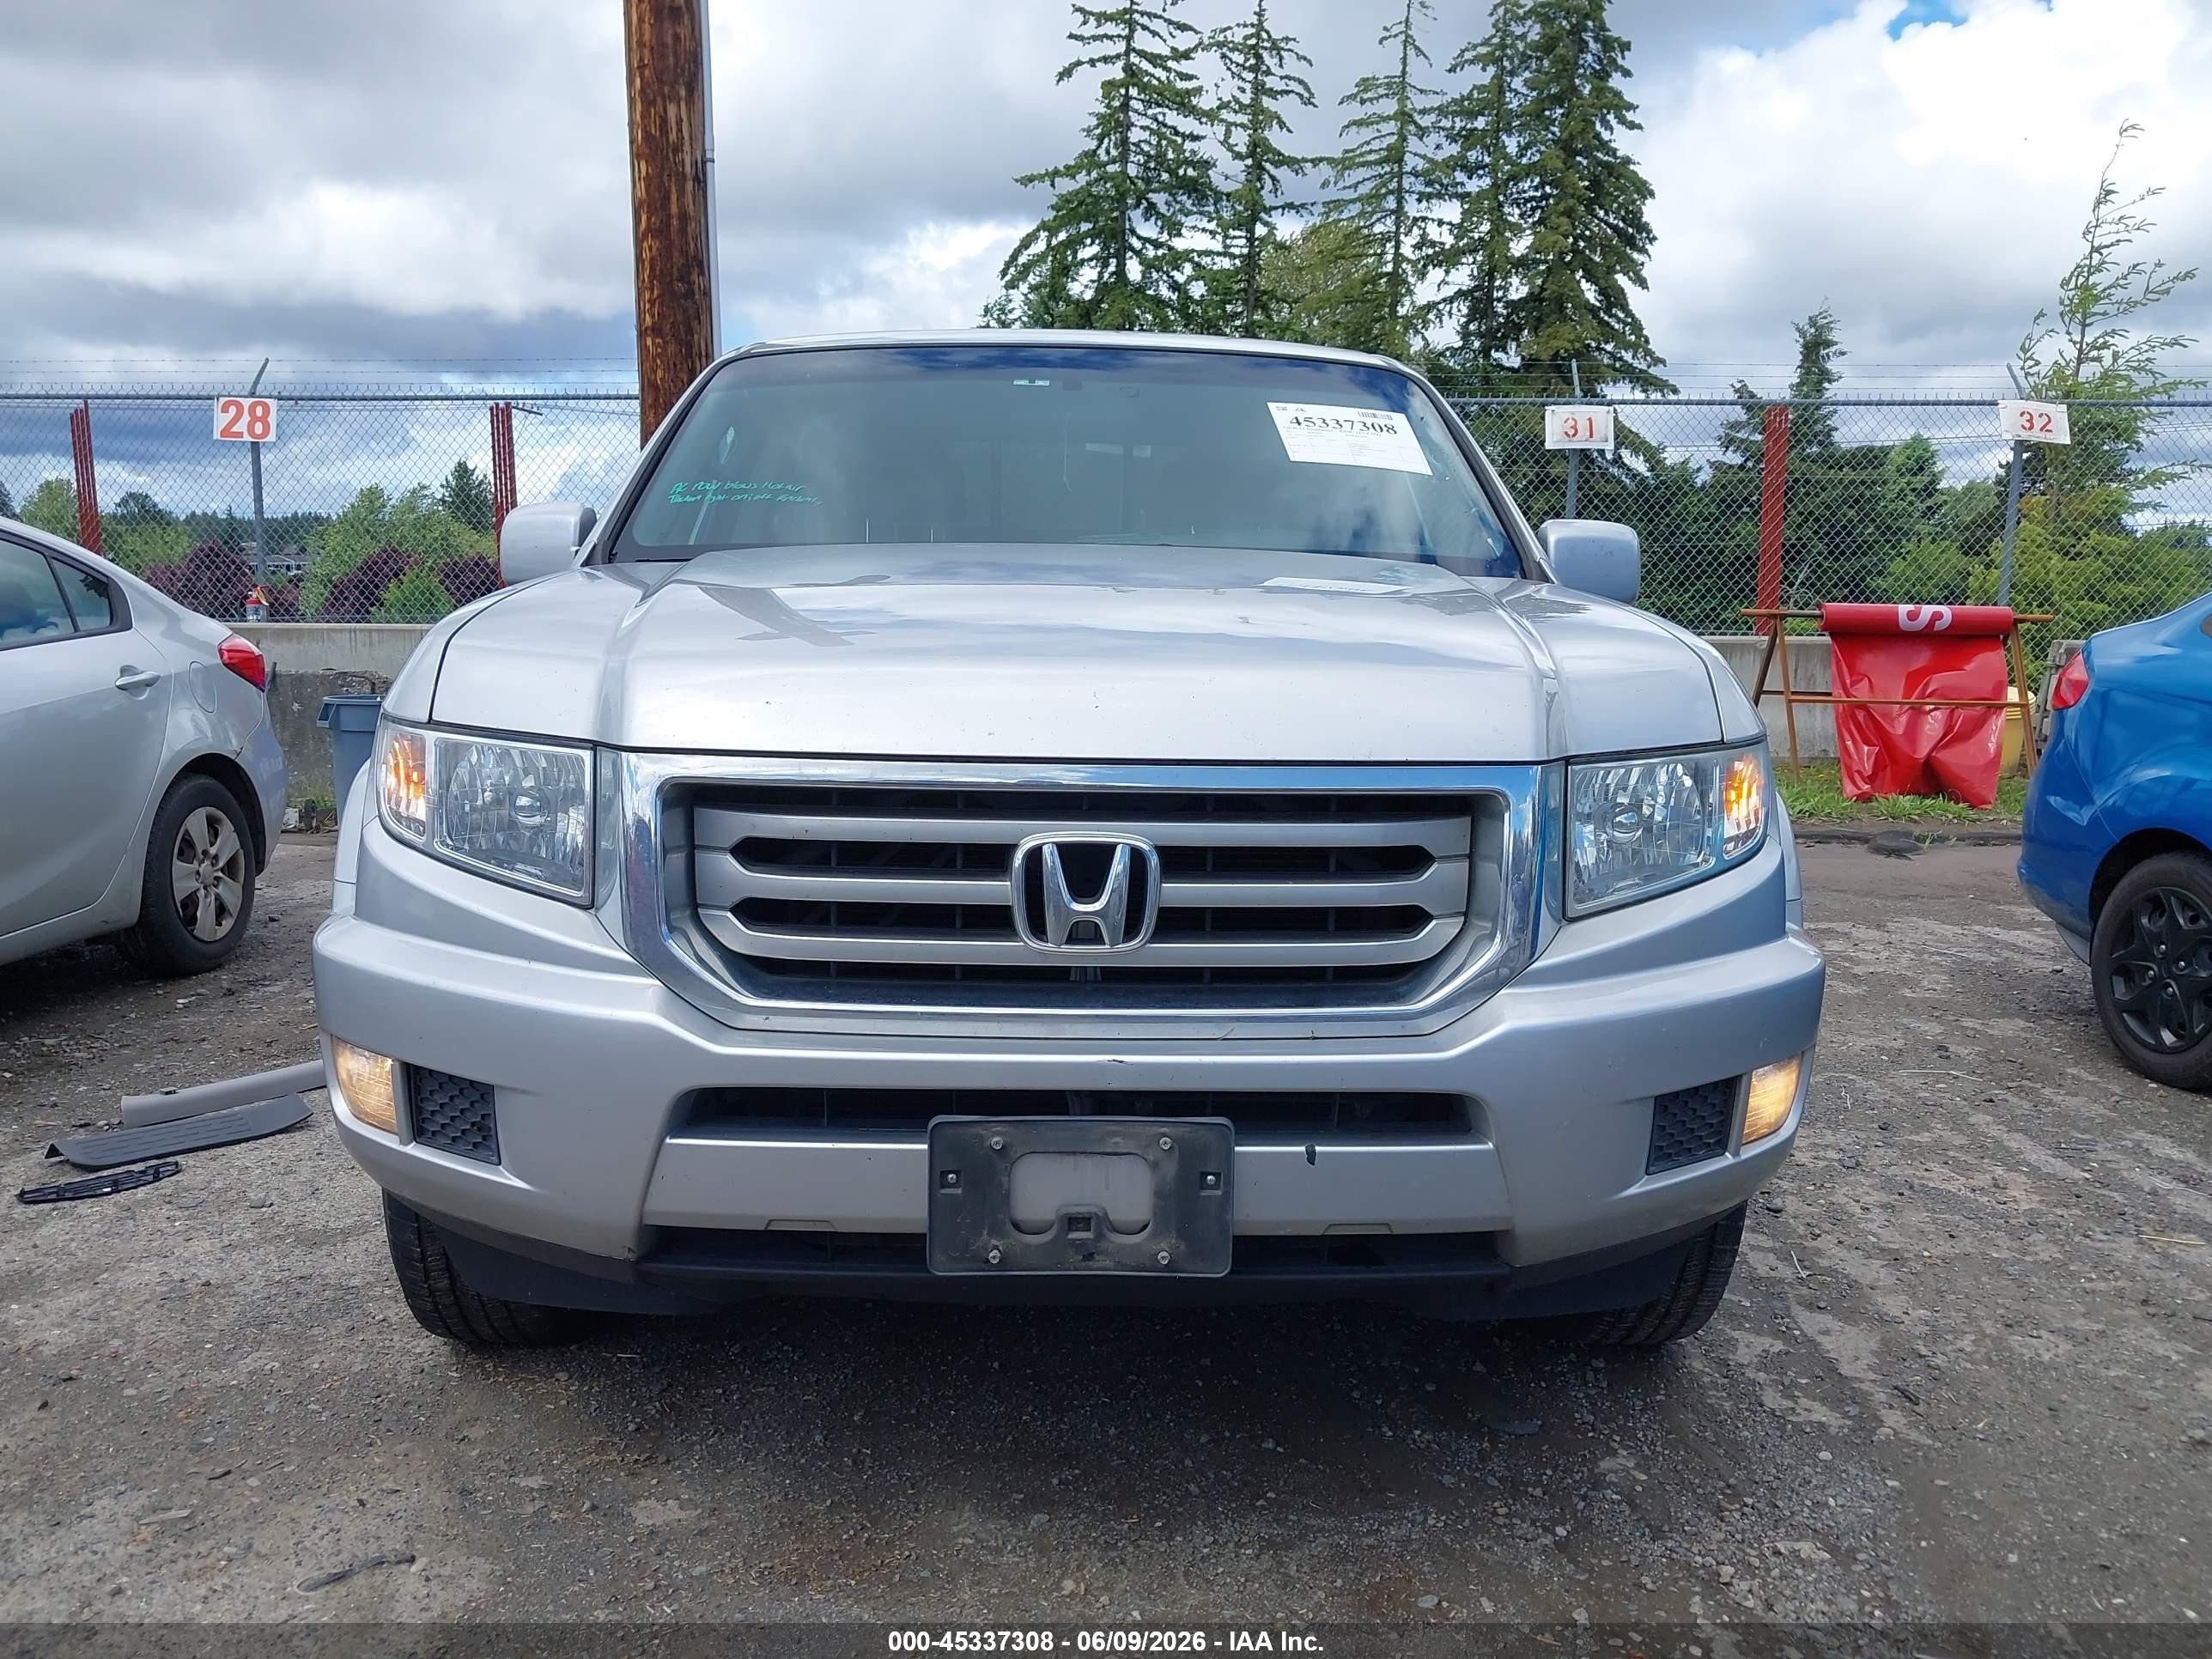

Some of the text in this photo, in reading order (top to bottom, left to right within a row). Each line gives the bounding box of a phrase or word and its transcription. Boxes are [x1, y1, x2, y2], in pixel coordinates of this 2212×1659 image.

[220, 399, 271, 440] 28
[1290, 416, 1398, 434] 45337308
[1564, 416, 1594, 439] 31
[2020, 410, 2053, 433] 32
